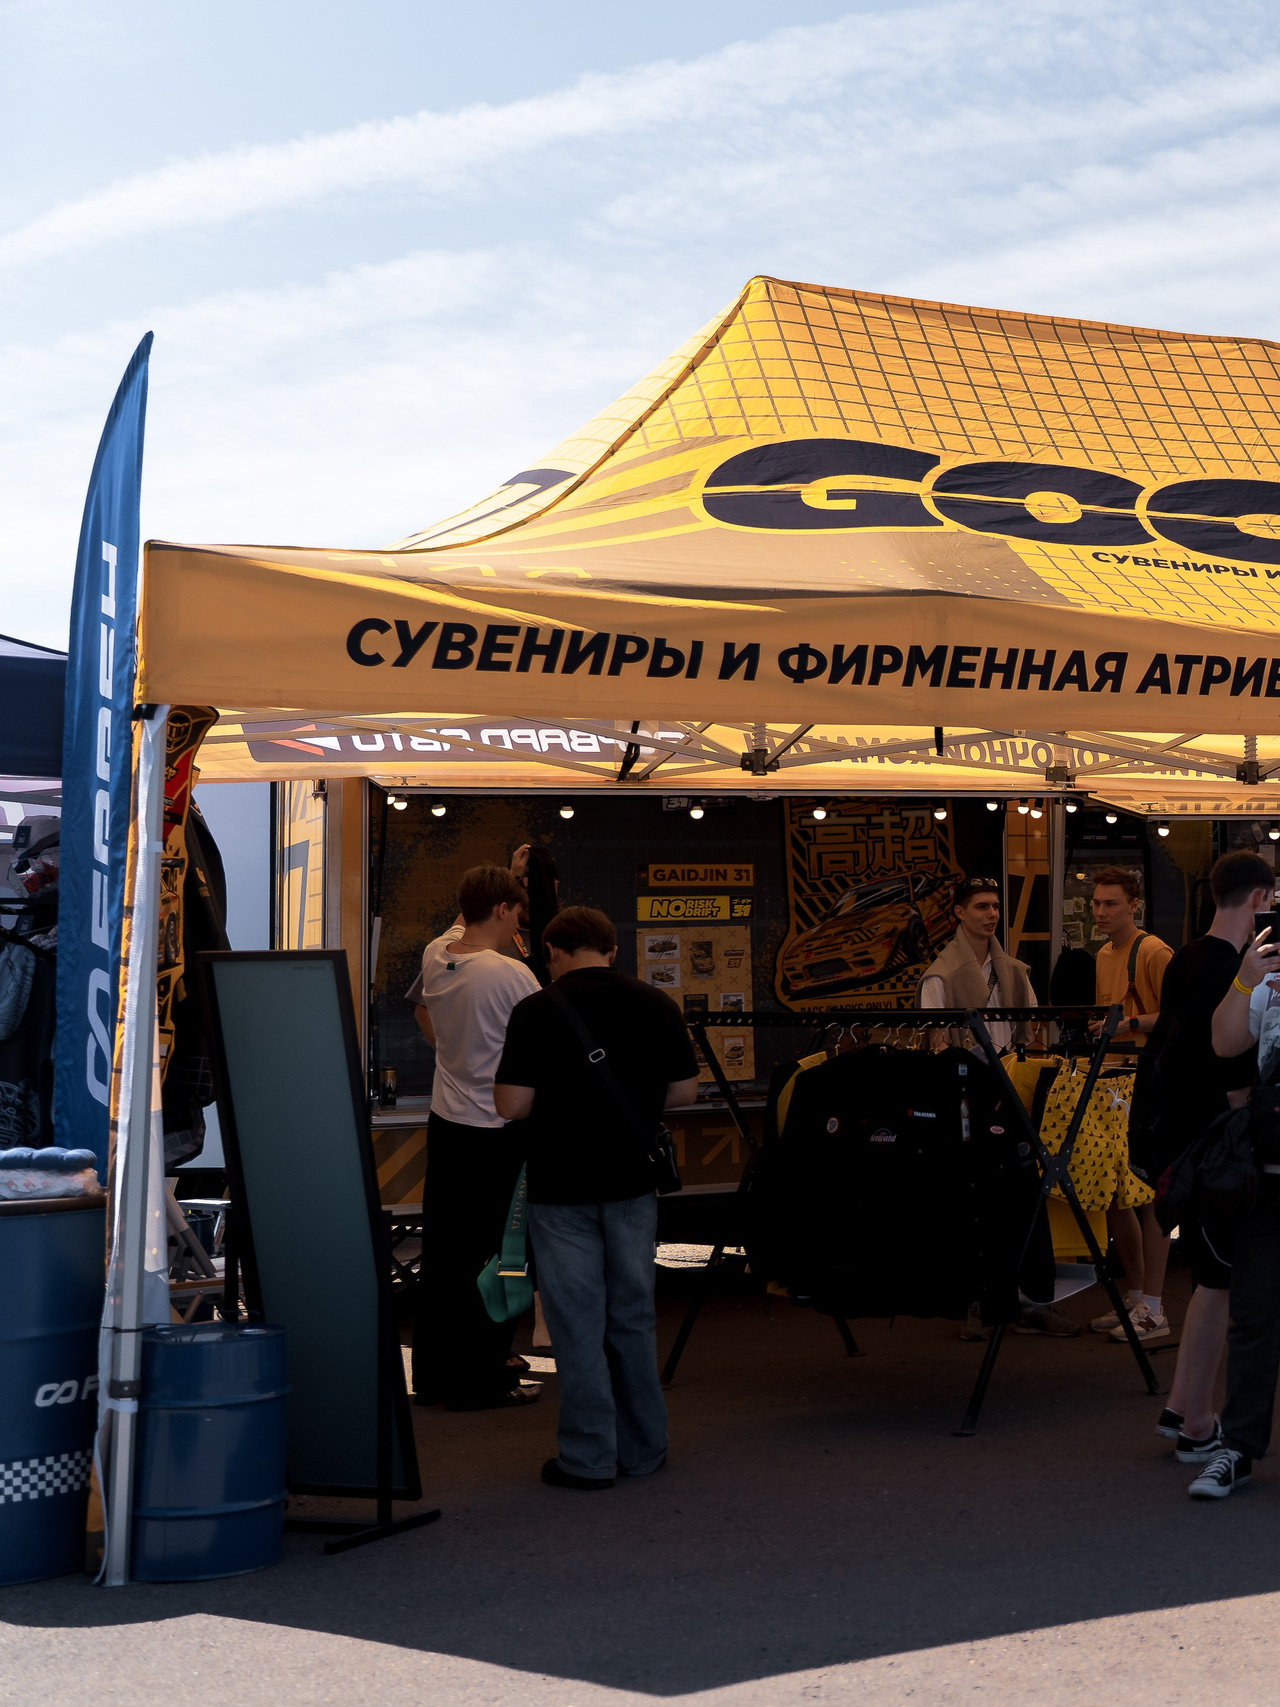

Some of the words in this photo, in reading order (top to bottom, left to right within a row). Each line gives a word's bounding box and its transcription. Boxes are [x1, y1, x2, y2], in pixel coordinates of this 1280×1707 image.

[1092, 551, 1257, 578] СУВЕНИРЫ
[345, 617, 703, 682] СУВЕНИРЫ
[718, 642, 761, 682] И
[777, 642, 1129, 694] ФИРМЕННАЯ
[653, 868, 728, 882] GAIDJIN
[734, 868, 751, 882] 31
[650, 899, 687, 918] NO
[685, 899, 714, 908] RISK
[684, 908, 721, 918] DRIFT
[731, 905, 752, 918] 31
[510, 1172, 527, 1229] AKATA
